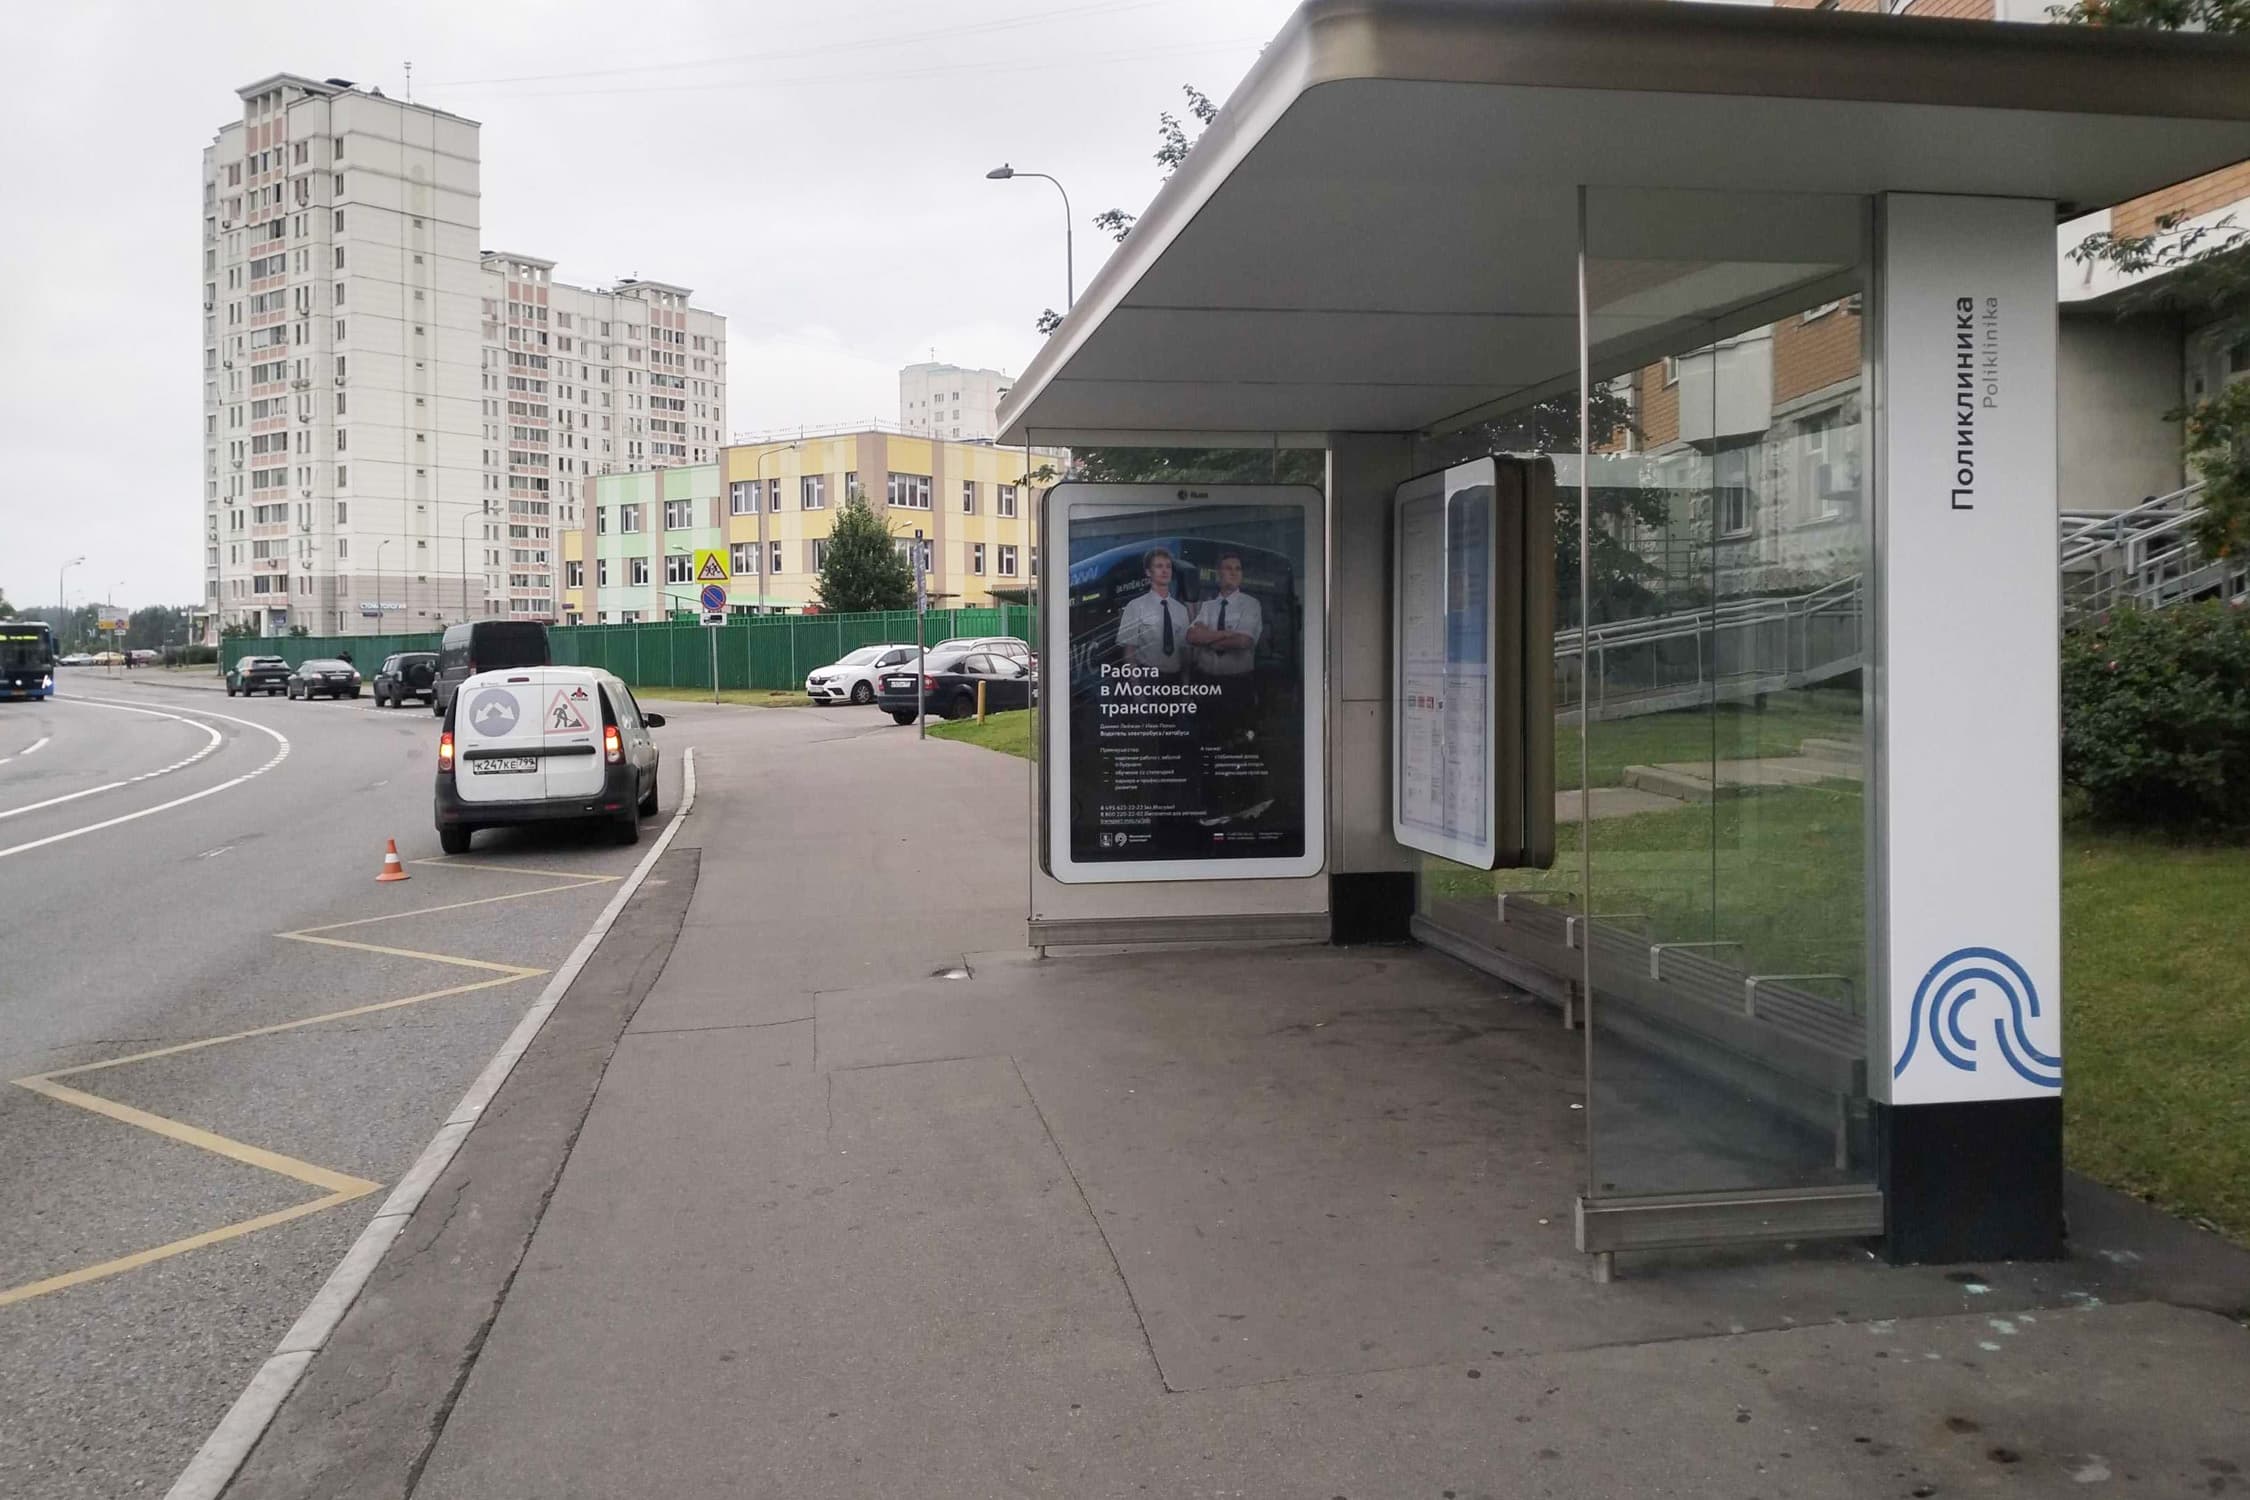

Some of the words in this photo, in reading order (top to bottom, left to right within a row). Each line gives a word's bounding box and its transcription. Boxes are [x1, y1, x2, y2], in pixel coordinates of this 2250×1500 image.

[1981, 296, 1999, 409] Poliklinika
[1951, 296, 1974, 510] Поликлиника
[1100, 663, 1160, 678] Работа
[1100, 684, 1110, 696] в
[1114, 682, 1222, 696] Московском
[1100, 701, 1198, 717] транспорте
